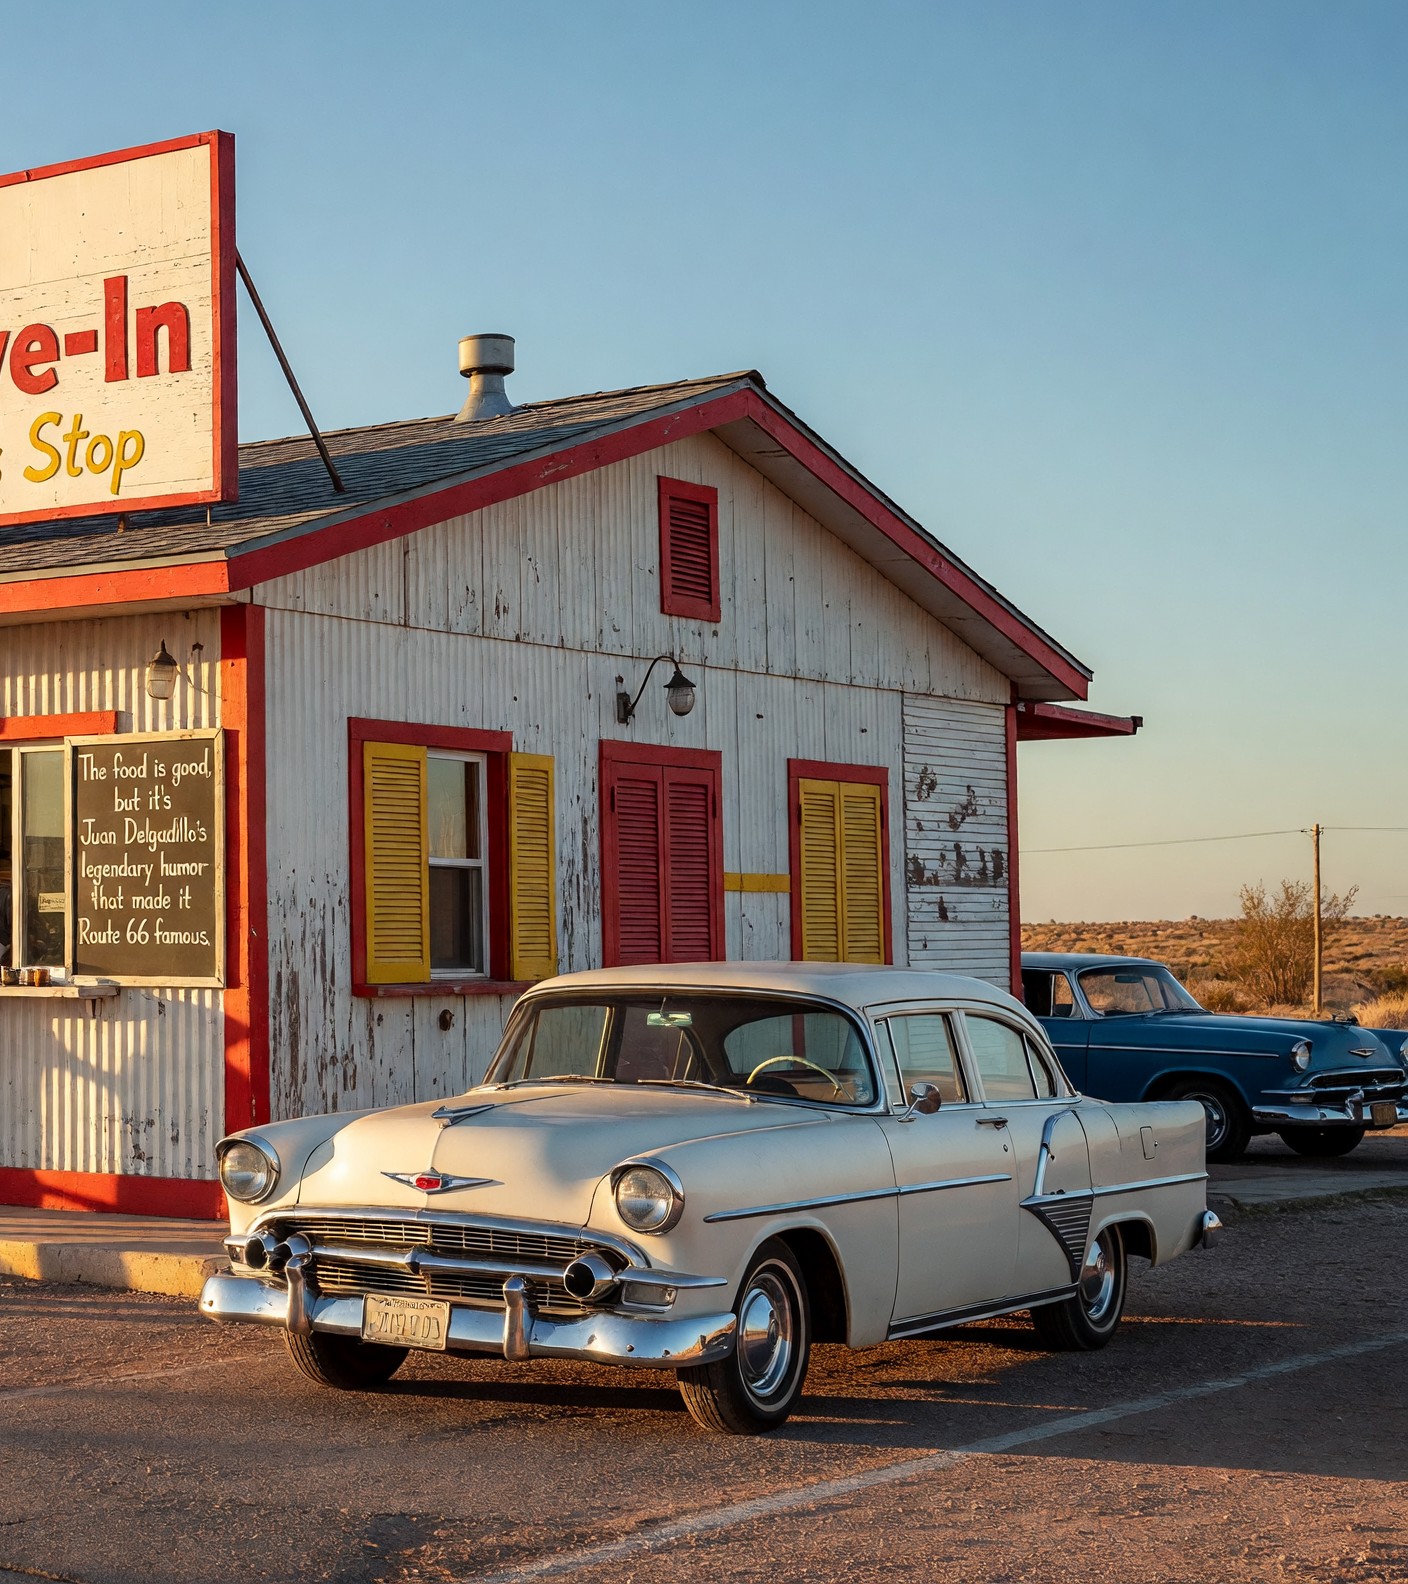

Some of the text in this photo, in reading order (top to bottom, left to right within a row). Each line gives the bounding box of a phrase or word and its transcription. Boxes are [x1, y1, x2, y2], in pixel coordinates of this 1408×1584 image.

[22, 412, 146, 496] Stop
[78, 753, 107, 781] The
[112, 752, 148, 779] food
[154, 759, 167, 778] is
[114, 784, 172, 812] but it's
[80, 817, 208, 853] Juan Delgadillo's
[81, 850, 210, 887] legendary humor
[91, 884, 125, 911] that
[132, 883, 172, 910] made
[179, 885, 192, 910] it
[78, 917, 121, 945] Route
[126, 917, 150, 945] 66
